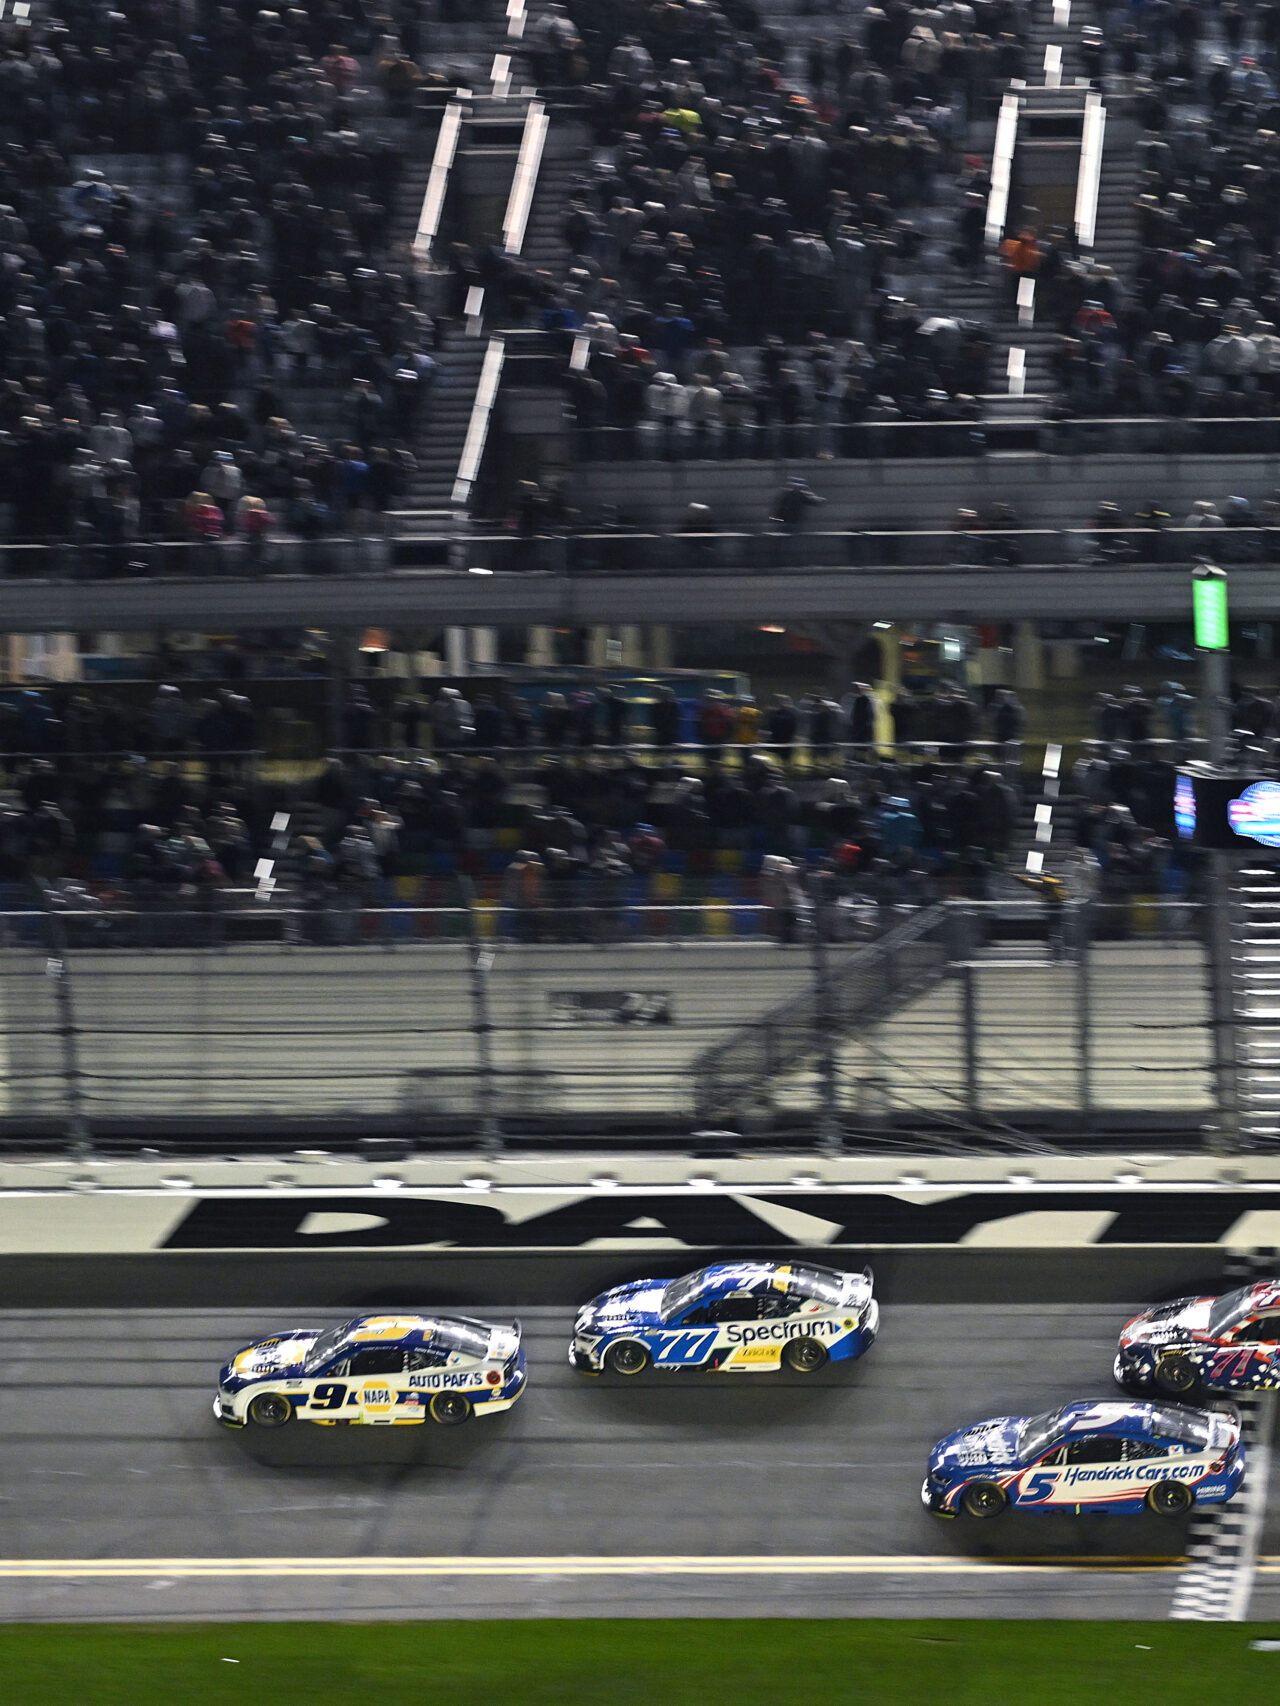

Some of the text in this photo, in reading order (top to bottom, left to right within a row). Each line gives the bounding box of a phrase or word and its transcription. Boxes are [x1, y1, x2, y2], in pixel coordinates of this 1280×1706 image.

[657, 1330, 713, 1360] 77
[727, 1320, 834, 1345] Spectrum
[1210, 1351, 1255, 1377] 71
[409, 1373, 483, 1387] AUTO PARTS
[310, 1384, 348, 1409] 9
[363, 1389, 391, 1404] NAPA
[1019, 1473, 1060, 1502] 5
